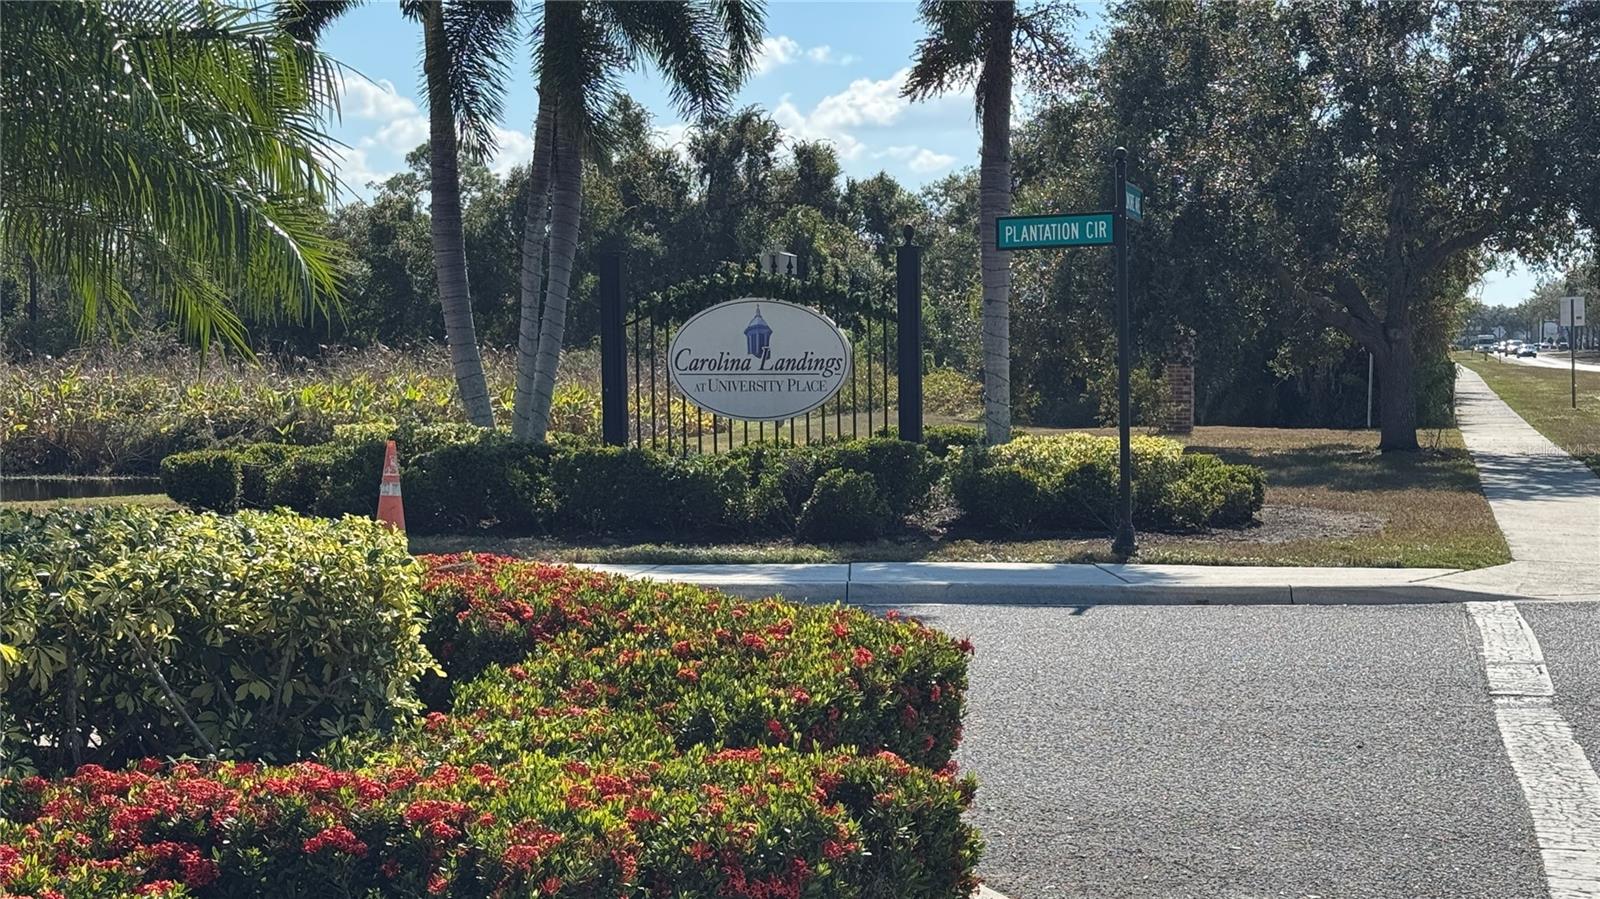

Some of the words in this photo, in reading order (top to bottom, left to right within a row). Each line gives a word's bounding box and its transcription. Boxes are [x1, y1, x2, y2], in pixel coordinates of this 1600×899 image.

[1005, 222, 1079, 243] PLANTATION
[1086, 221, 1107, 239] CIR
[675, 348, 752, 372] Carolina
[758, 347, 843, 378] Landings
[708, 379, 785, 393] UNIVERSITY
[787, 378, 828, 393] PLACE
